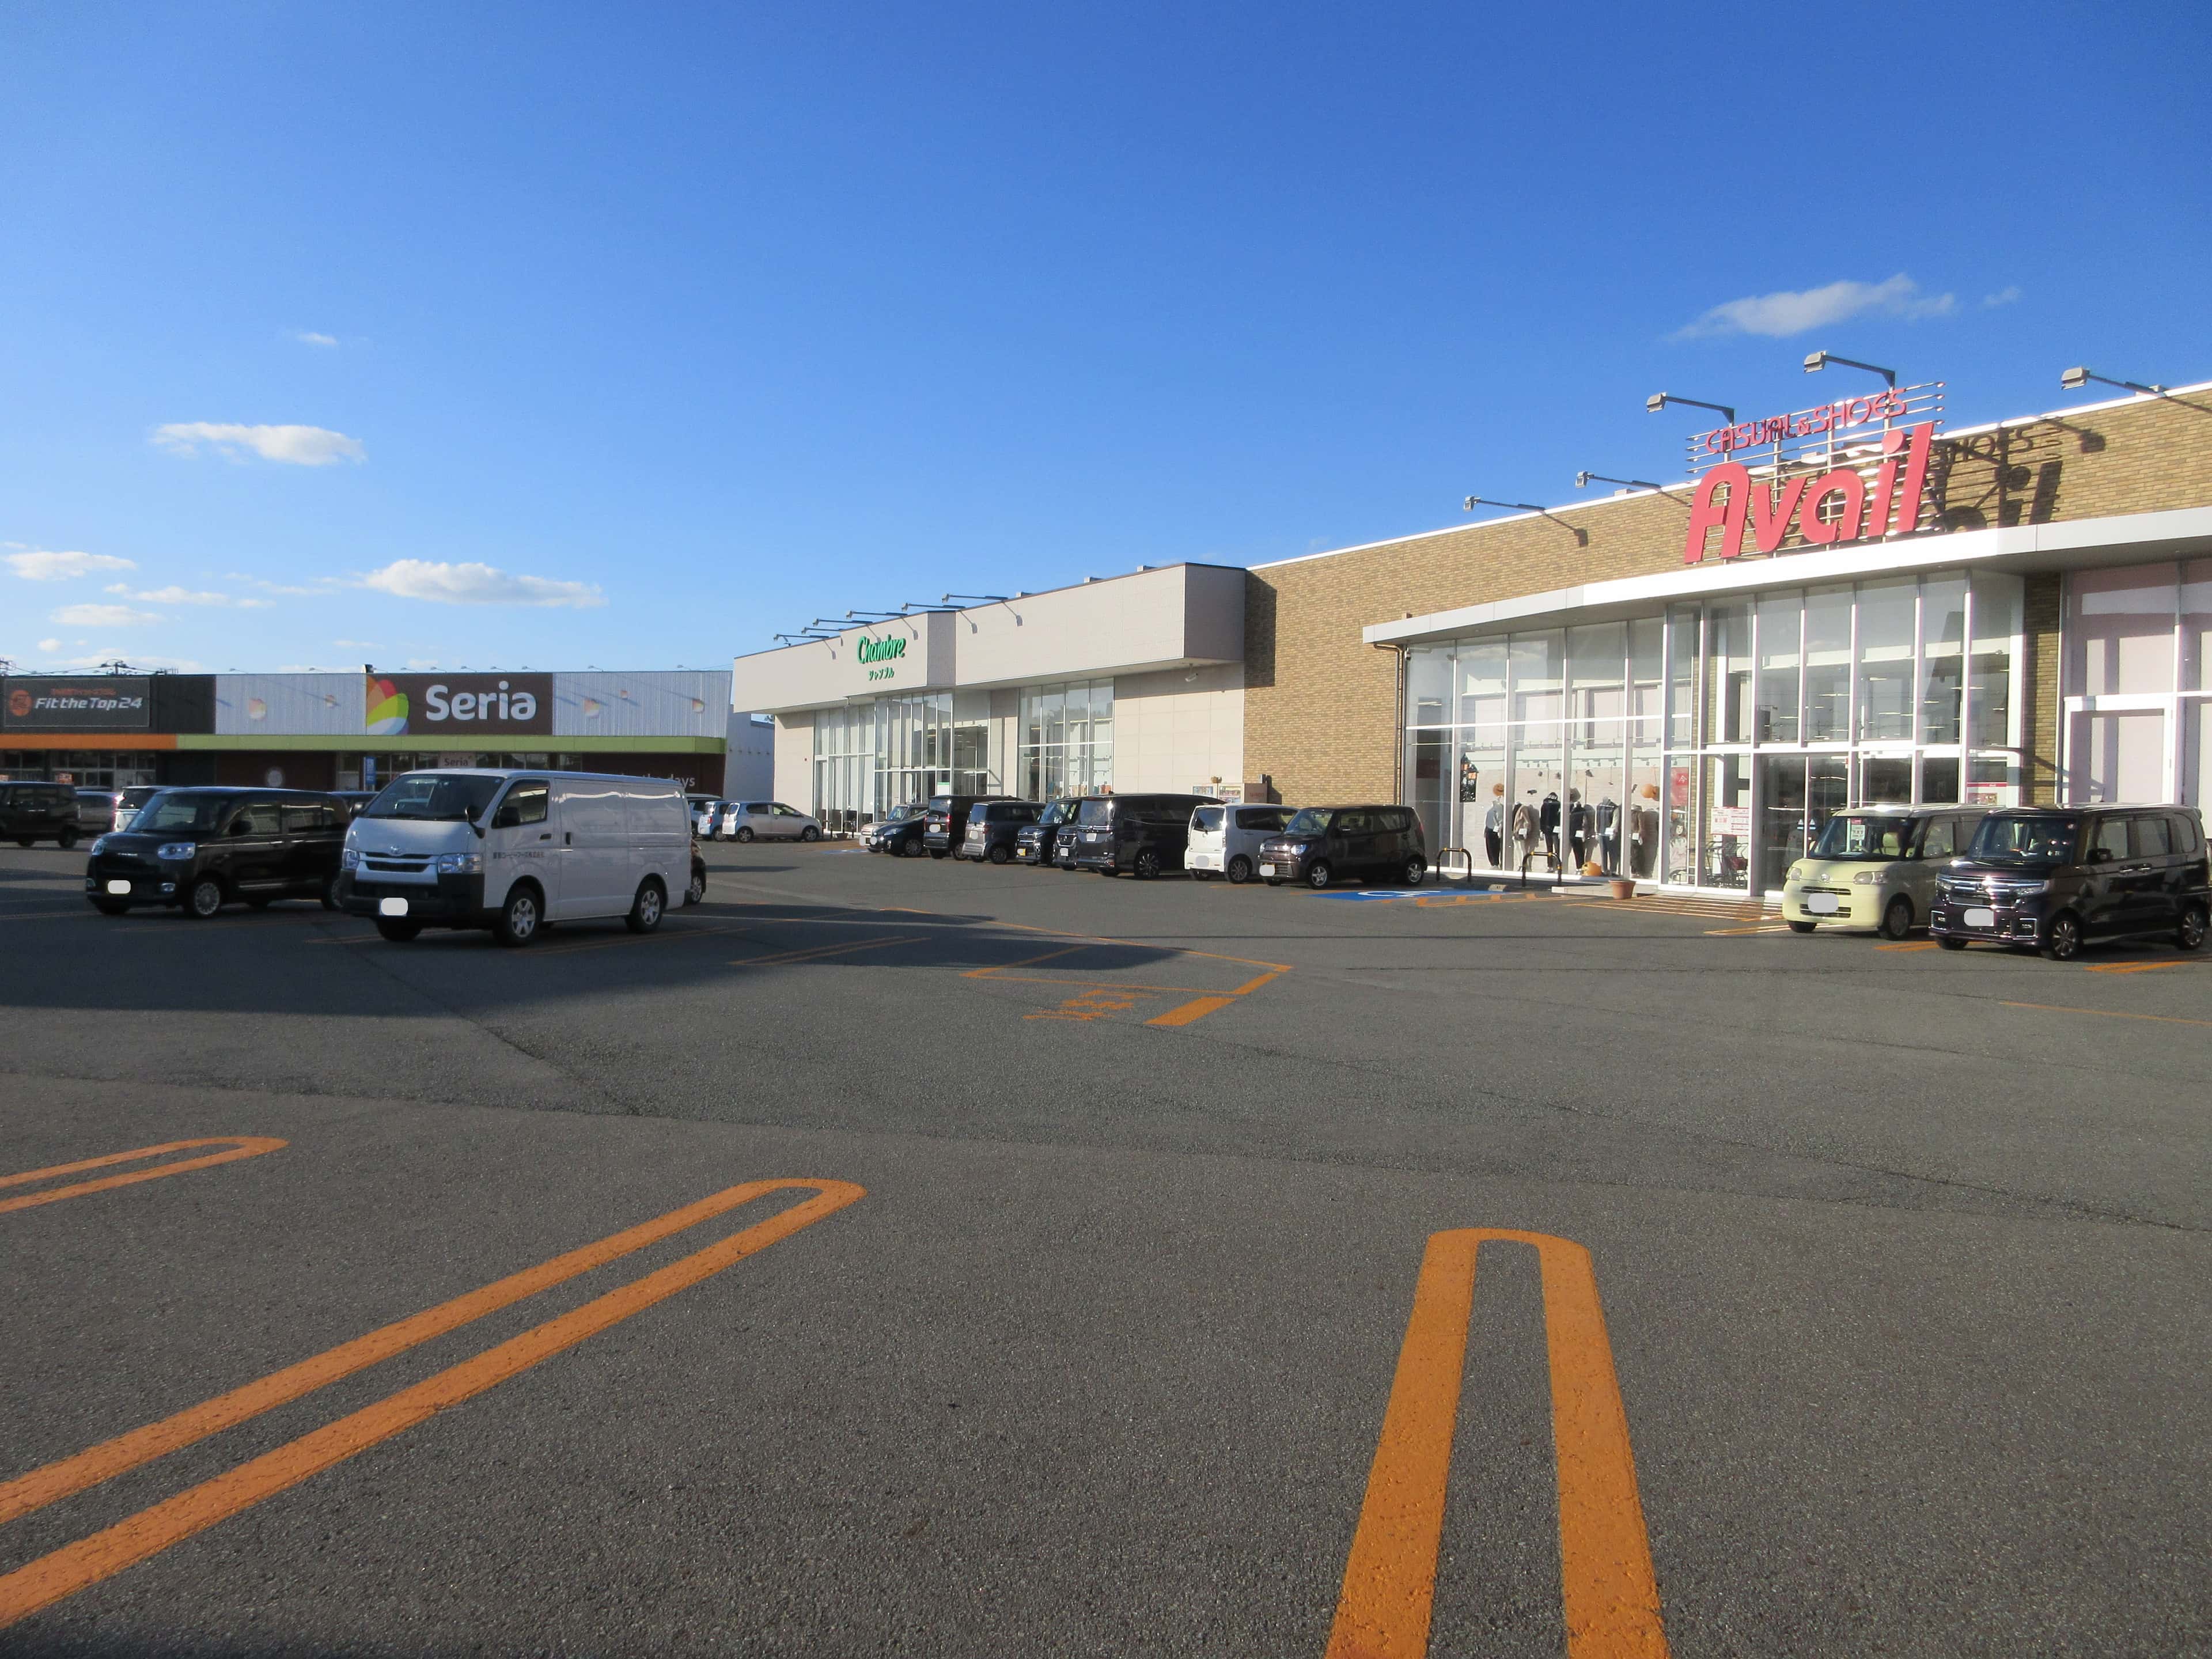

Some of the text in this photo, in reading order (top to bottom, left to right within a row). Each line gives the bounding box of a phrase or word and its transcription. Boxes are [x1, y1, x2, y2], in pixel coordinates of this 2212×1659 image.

[1705, 388, 1908, 453] CASUAL & SHOES
[1684, 422, 1934, 564] Avail
[857, 634, 907, 664] Chambre
[426, 680, 537, 721] Seria
[444, 757, 468, 766] Seria
